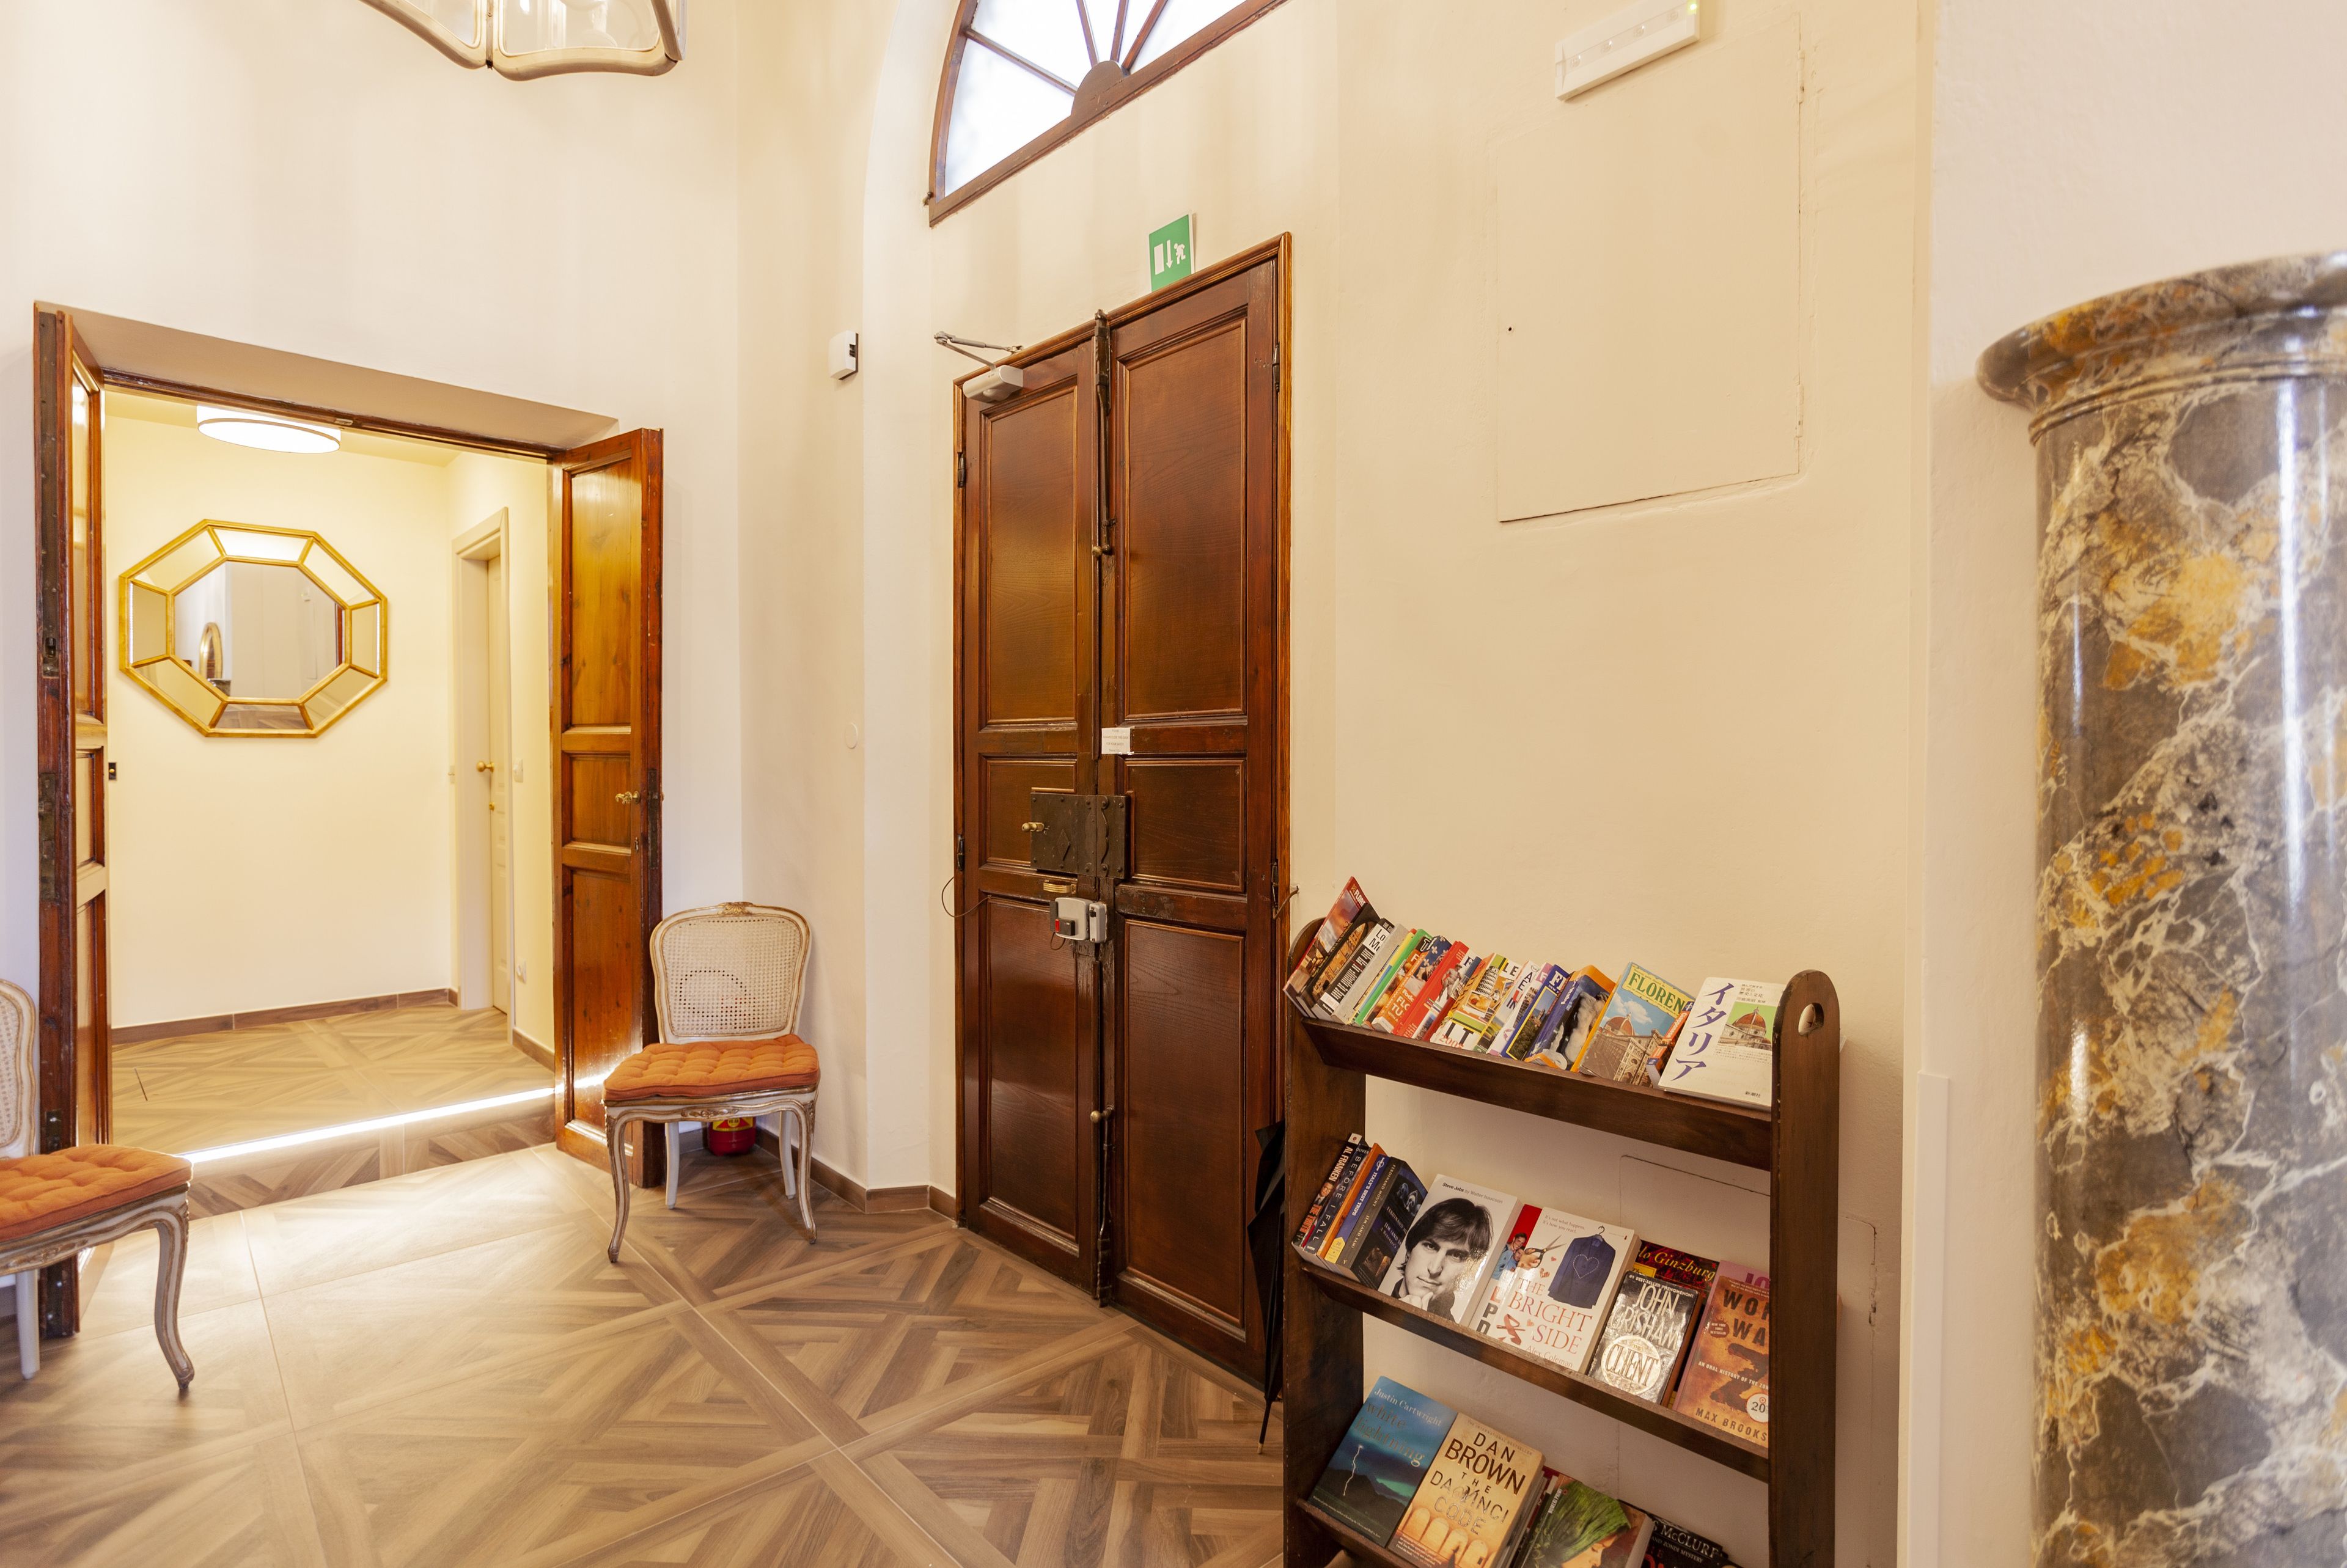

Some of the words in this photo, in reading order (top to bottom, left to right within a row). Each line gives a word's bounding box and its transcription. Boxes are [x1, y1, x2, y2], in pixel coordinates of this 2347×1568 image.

[1391, 1003, 1404, 1018] TU
[1670, 983, 1735, 1082] イタリア
[1343, 1146, 1353, 1154] AL
[1328, 1154, 1349, 1182] FRANKEN
[1335, 1156, 1362, 1200] BEFORE
[1352, 1200, 1362, 1216] TRIPS
[1359, 1188, 1369, 1202] BEST
[1312, 1214, 1331, 1241] FALL
[1654, 1251, 1716, 1282] Ginzburg
[1519, 1277, 1546, 1296] THE
[1632, 1283, 1680, 1319] JOHN
[1636, 1277, 1661, 1288] BEST-SELLER
[1661, 1284, 1694, 1299] PHENOMENON!
[1508, 1291, 1593, 1332] BRIGHT
[1610, 1303, 1681, 1350] GRISHAM
[1532, 1324, 1582, 1355] SIDE
[1526, 1346, 1541, 1357] Alex
[1544, 1351, 1573, 1369] Coleman
[1606, 1344, 1659, 1387] CLIENT
[1706, 1363, 1717, 1372] ORAL
[1719, 1368, 1740, 1380] HISTORY
[1367, 1402, 1406, 1429] white
[1375, 1388, 1398, 1405] Justin
[1399, 1399, 1442, 1427] Cartwright
[1695, 1407, 1718, 1423] MAX
[1722, 1418, 1768, 1442] BROOKS
[1354, 1416, 1425, 1467] lightning
[1473, 1432, 1516, 1463] DAN
[1444, 1438, 1526, 1495] BROWN
[1430, 1470, 1452, 1494] DA
[1460, 1486, 1509, 1523] VINCI
[1461, 1471, 1492, 1494] THE
[1434, 1496, 1486, 1536] CODE
[1680, 1549, 1704, 1564] MYSTERY
